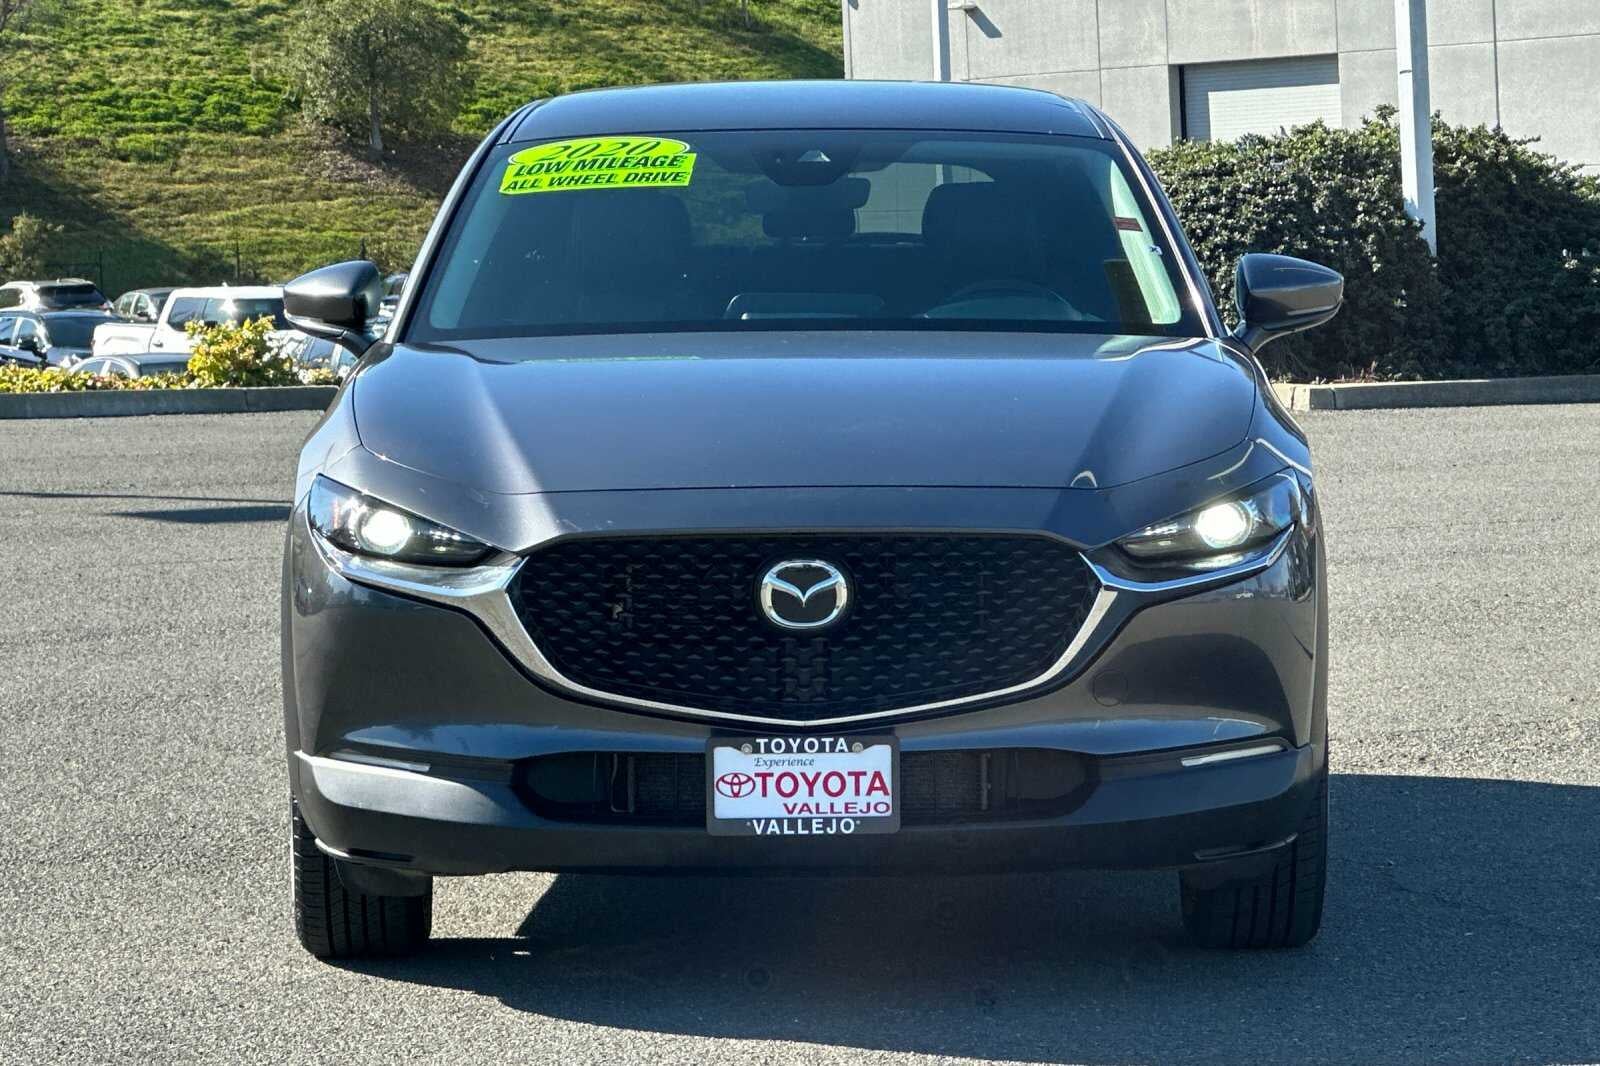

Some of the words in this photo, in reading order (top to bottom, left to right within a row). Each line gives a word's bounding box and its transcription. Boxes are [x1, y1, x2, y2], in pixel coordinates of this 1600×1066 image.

[535, 141, 661, 162] 2020
[514, 161, 570, 177] LOW
[572, 154, 688, 173] MILEAGE
[503, 179, 542, 191] ALL
[548, 174, 618, 186] WHEEL
[622, 172, 689, 183] DRIVE
[756, 737, 848, 754] TOYOTA
[754, 756, 815, 769] Experience
[754, 770, 890, 798] TOYOTA
[783, 801, 891, 815] VALLEJO
[752, 818, 855, 835] VALLEJO
